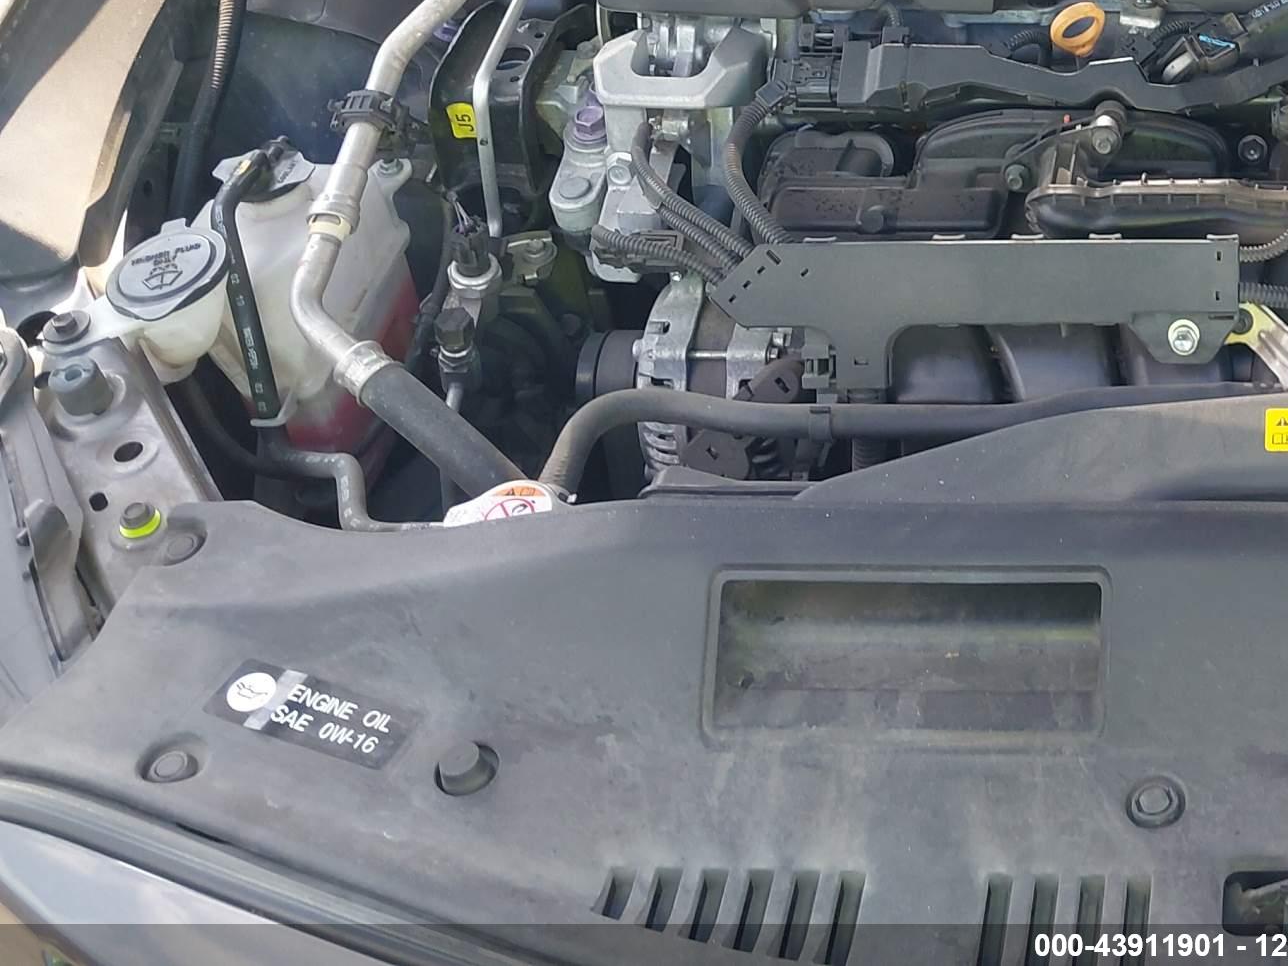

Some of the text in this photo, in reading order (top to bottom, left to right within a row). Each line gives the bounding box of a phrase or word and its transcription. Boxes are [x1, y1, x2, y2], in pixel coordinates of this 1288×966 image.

[455, 113, 474, 132] J5
[270, 705, 380, 754] SAE 0W-16
[287, 683, 392, 733] ENGINE OIL
